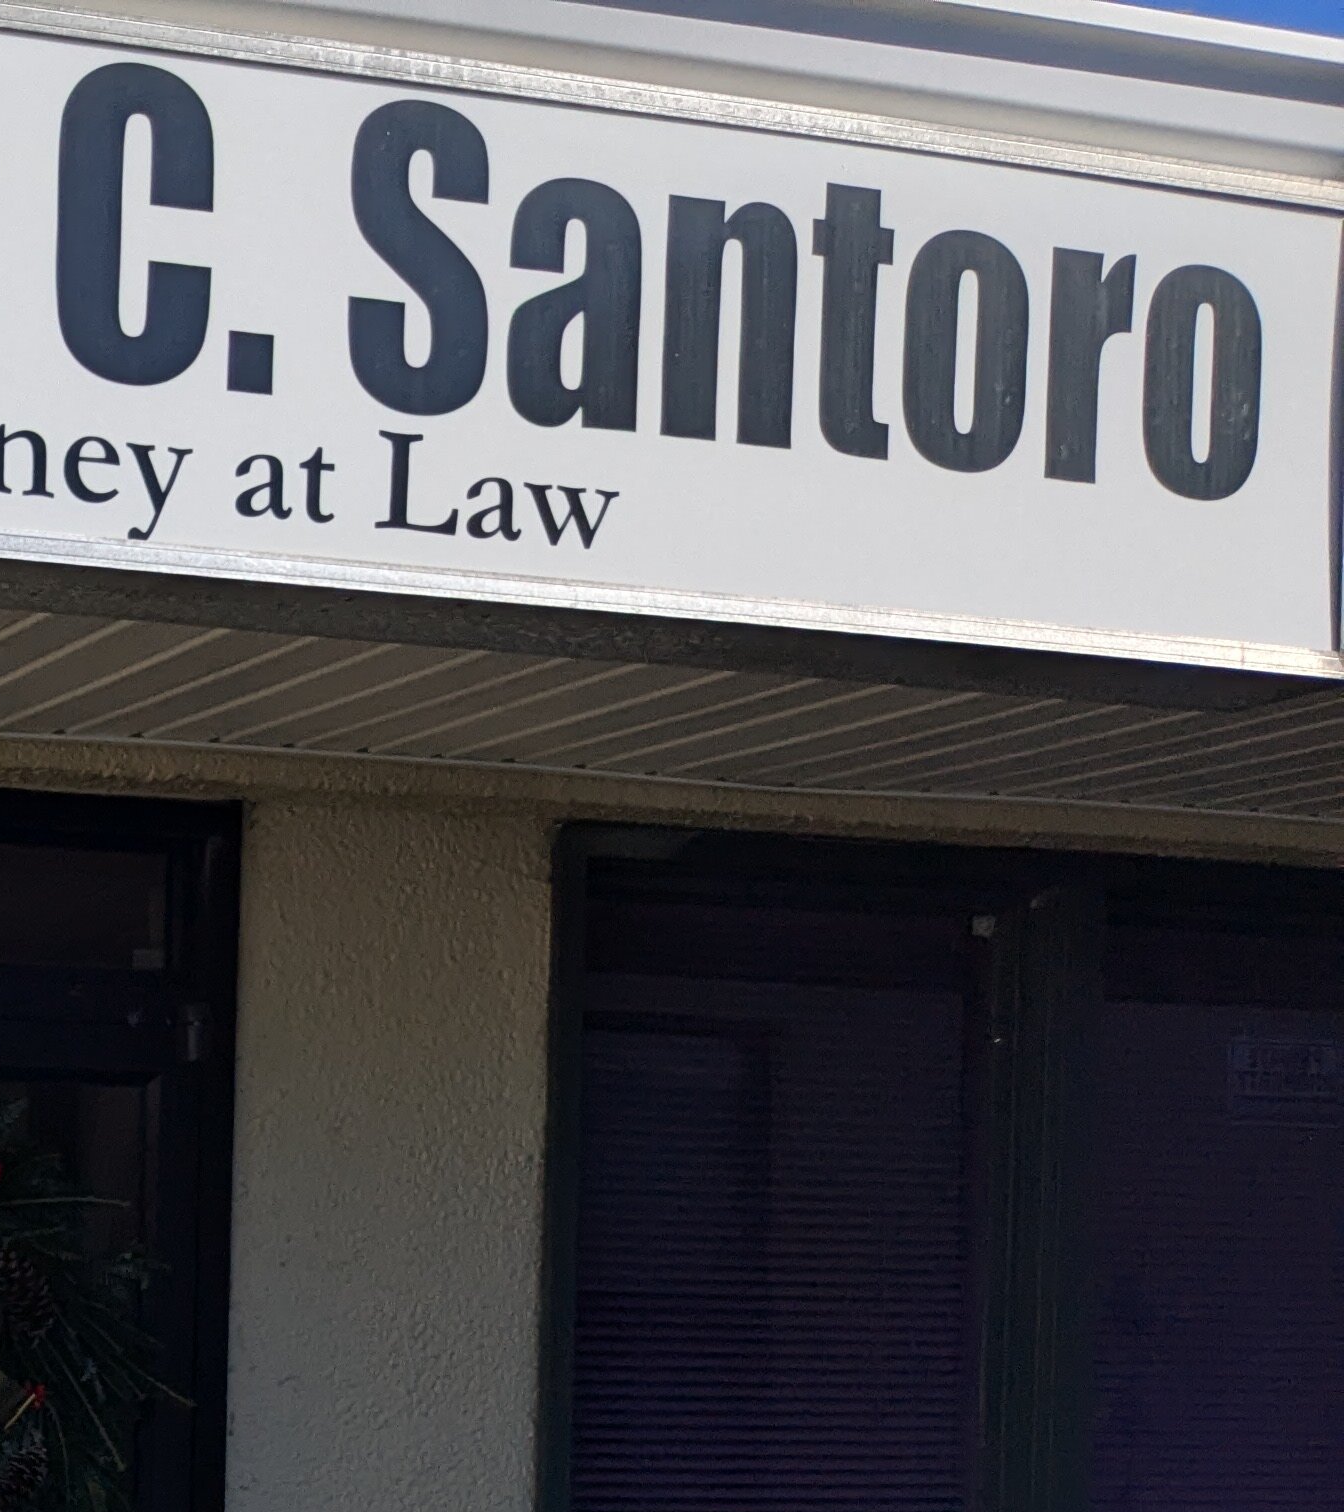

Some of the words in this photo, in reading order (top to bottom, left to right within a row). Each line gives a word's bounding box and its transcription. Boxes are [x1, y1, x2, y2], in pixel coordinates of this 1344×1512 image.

[55, 62, 276, 397] C.
[347, 99, 1264, 502] Santoro
[234, 445, 336, 525] at
[373, 430, 621, 550] Law
